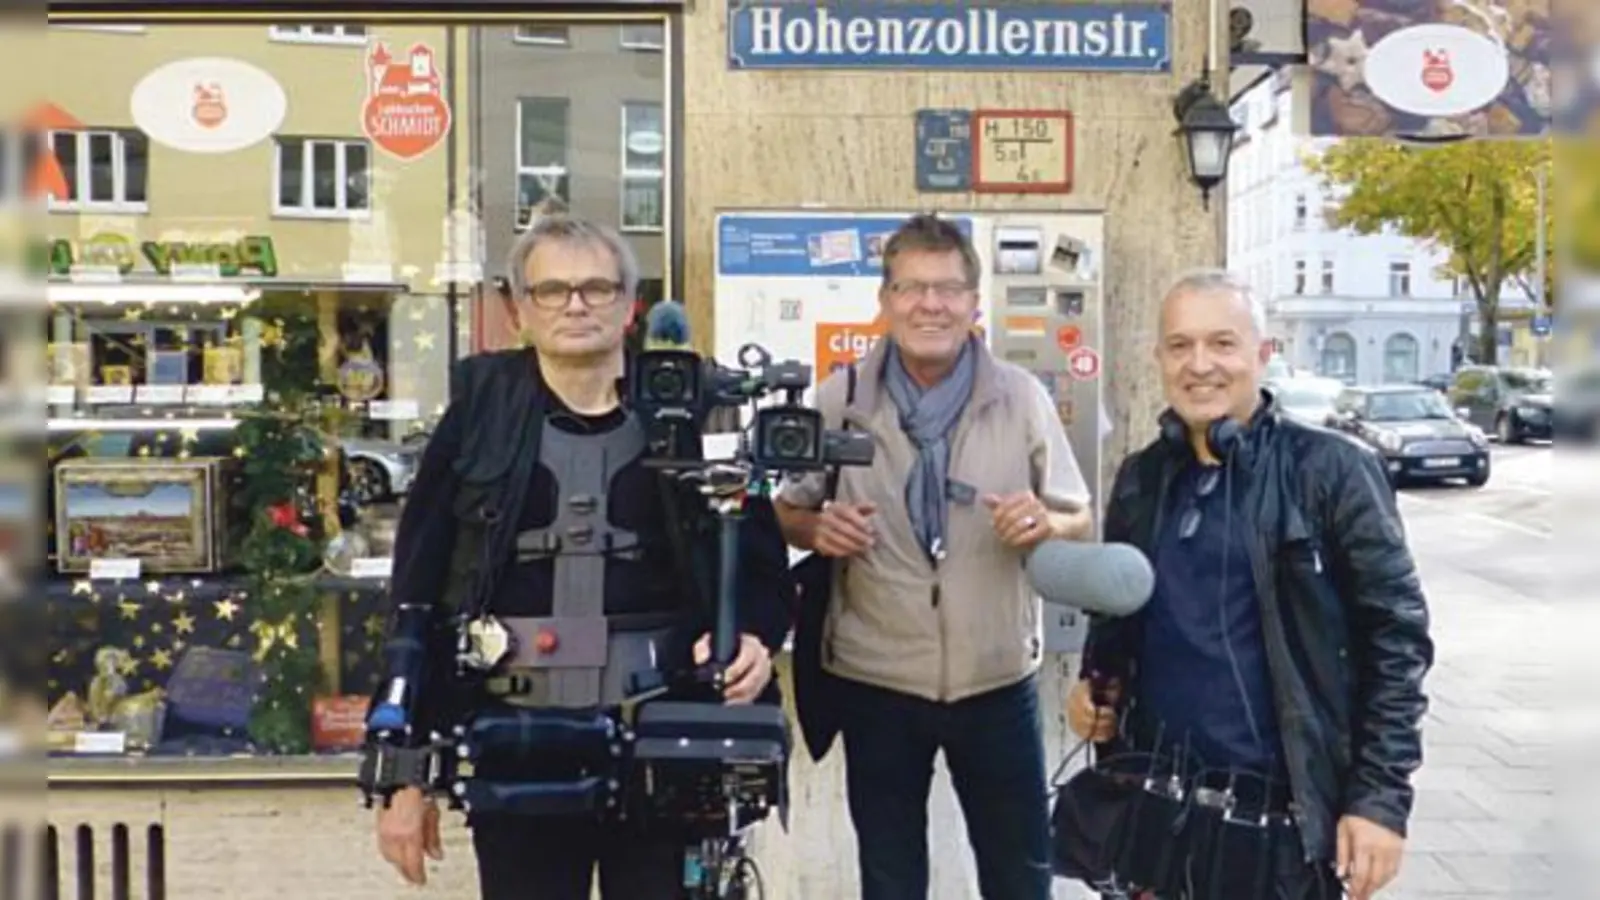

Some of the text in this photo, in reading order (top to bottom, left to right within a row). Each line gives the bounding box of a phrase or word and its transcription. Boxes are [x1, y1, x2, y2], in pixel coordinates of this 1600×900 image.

[749, 7, 1158, 58] Hohenzollernstr.
[371, 116, 442, 136] SCHMIDT
[985, 120, 999, 137] H
[1013, 119, 1049, 138] 150
